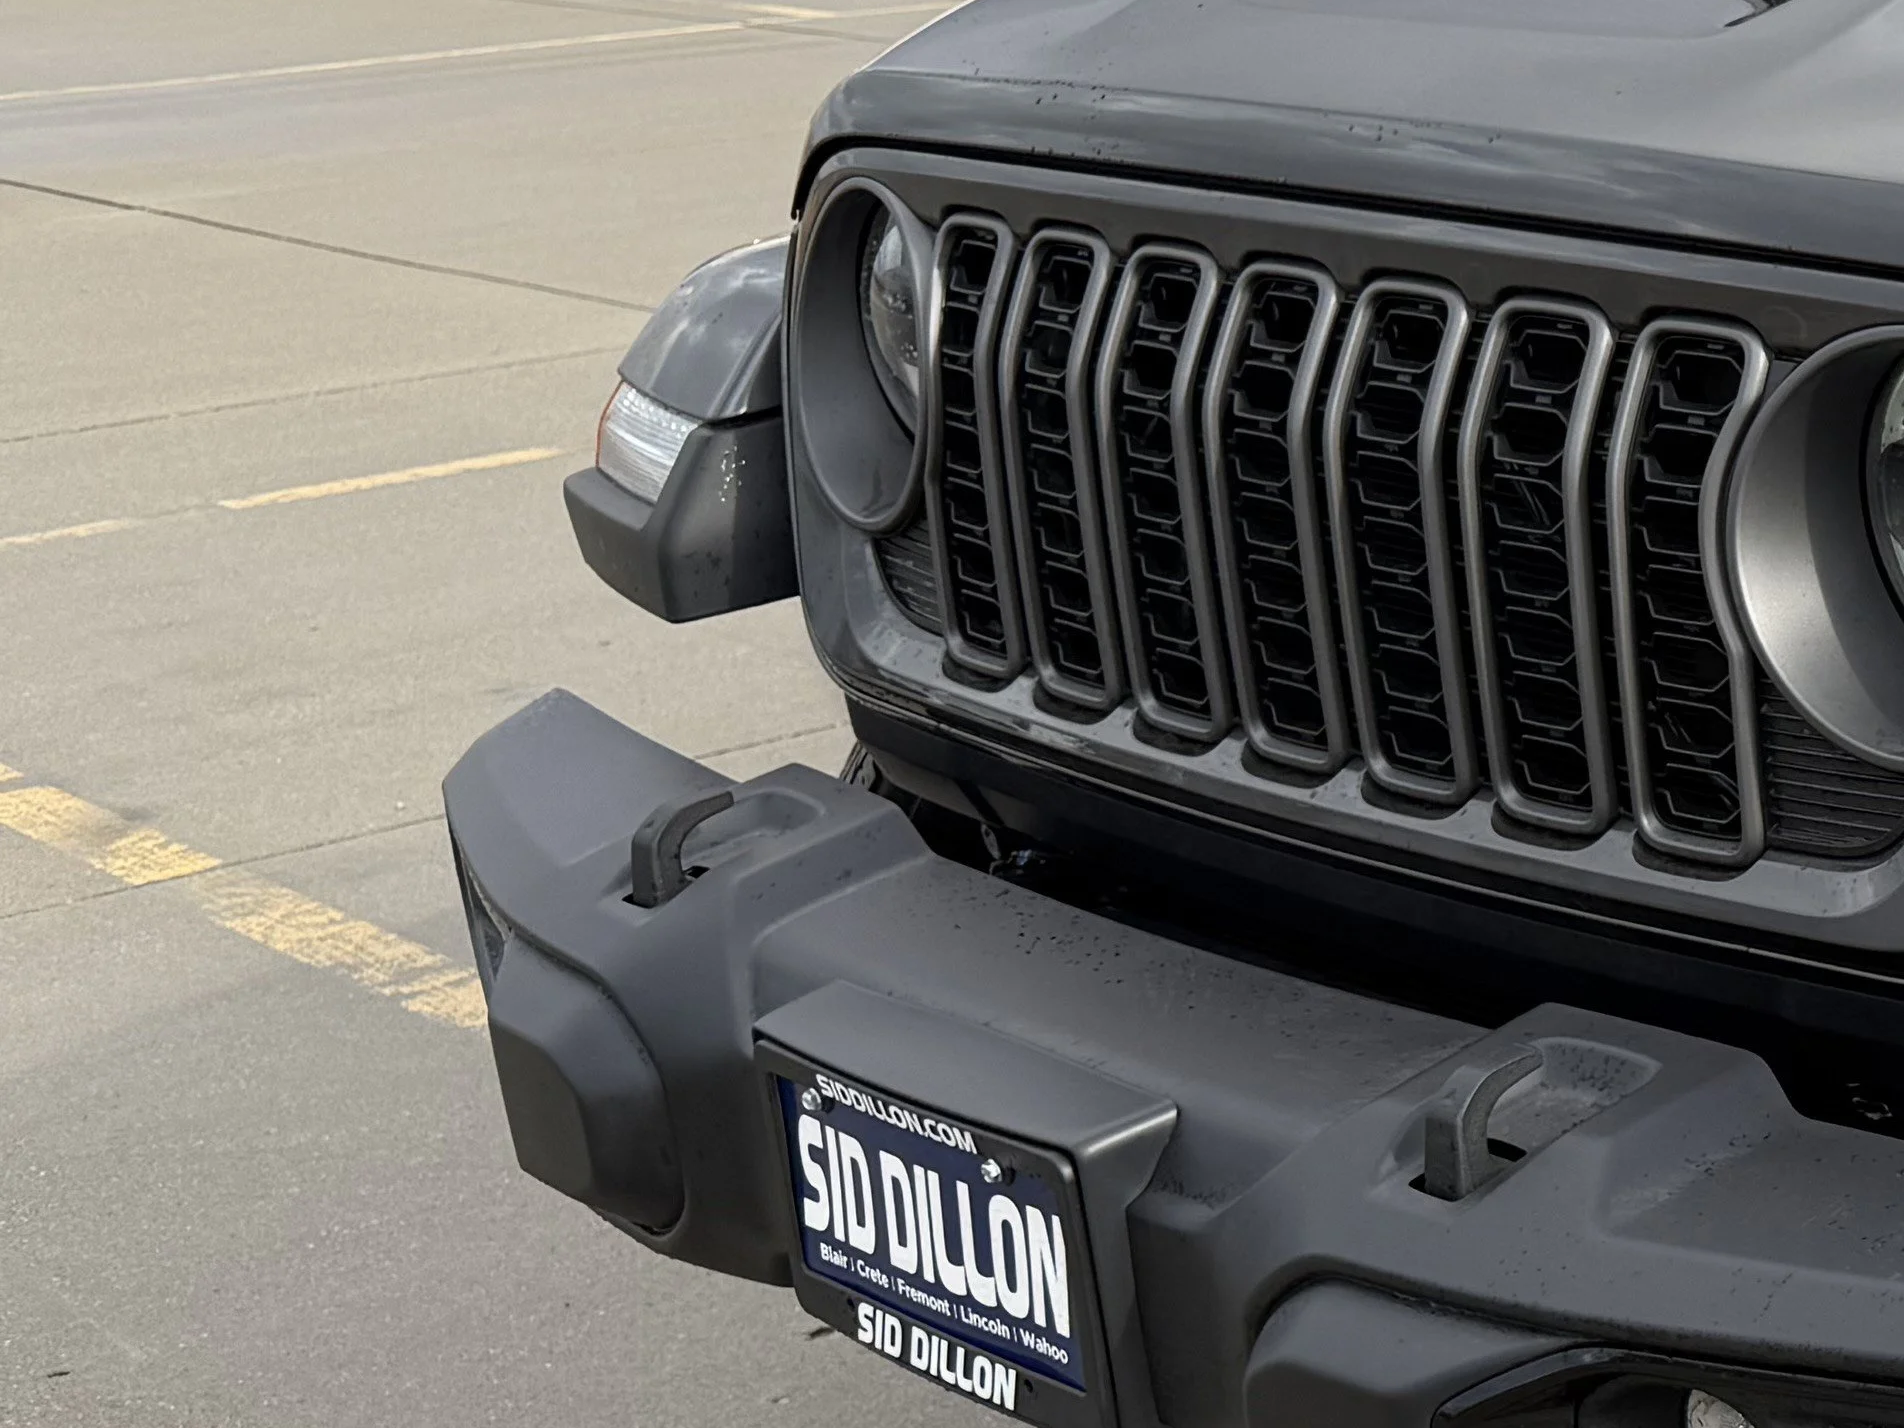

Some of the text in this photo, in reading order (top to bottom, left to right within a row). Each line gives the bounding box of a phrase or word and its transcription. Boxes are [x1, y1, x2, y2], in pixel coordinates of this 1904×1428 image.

[815, 1073, 978, 1155] SIDDILLON.COM
[798, 1113, 1071, 1339] SID DILLON
[819, 1242, 1069, 1365] Blair Crete Fremont Lincoln Wahoo
[857, 1301, 1018, 1412] SID DILLON
